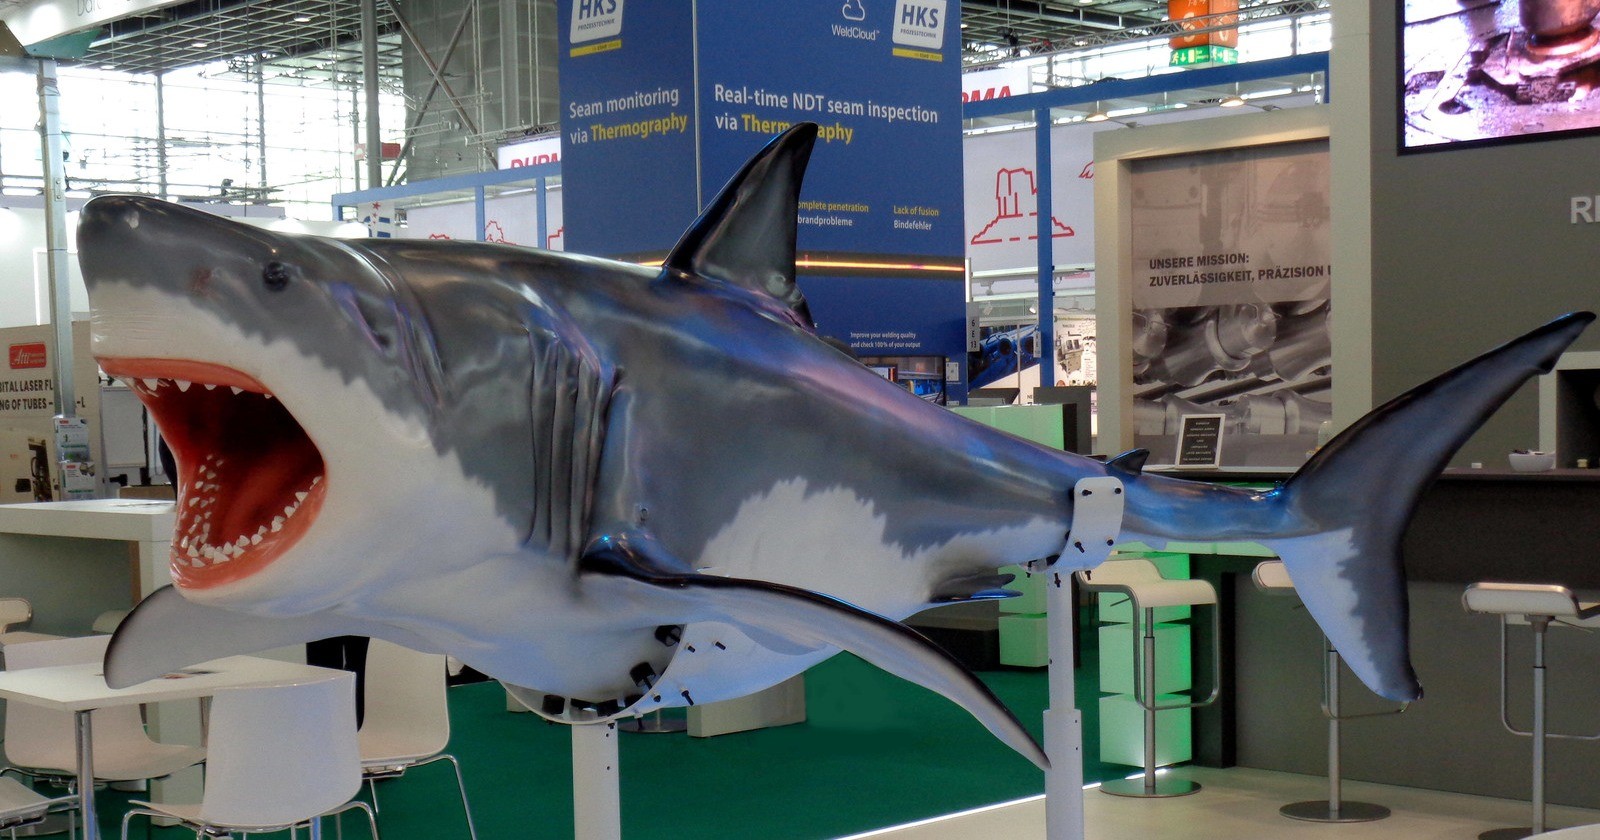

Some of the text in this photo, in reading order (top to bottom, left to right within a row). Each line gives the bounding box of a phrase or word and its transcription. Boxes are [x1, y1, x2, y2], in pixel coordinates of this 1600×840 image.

[579, 0, 617, 20] HKS
[901, 4, 939, 28] HKS
[569, 87, 679, 118] Seam monitoring
[714, 83, 938, 123] Real-time NDT seam inspection
[570, 112, 687, 145] via Thermography
[715, 112, 853, 145] via Thermaphy
[828, 203, 869, 212] penetration
[893, 205, 939, 216] Lack of fusion
[893, 219, 932, 230] Bindefehler
[1149, 253, 1250, 270] UNSERE MISSION:
[1149, 270, 1255, 287] ZUVERLÄSSIGKEIT,
[1258, 265, 1324, 281] PRÄZISION
[20, 380, 44, 392] LASER
[12, 399, 21, 410] OF
[23, 398, 47, 410] TUBES
